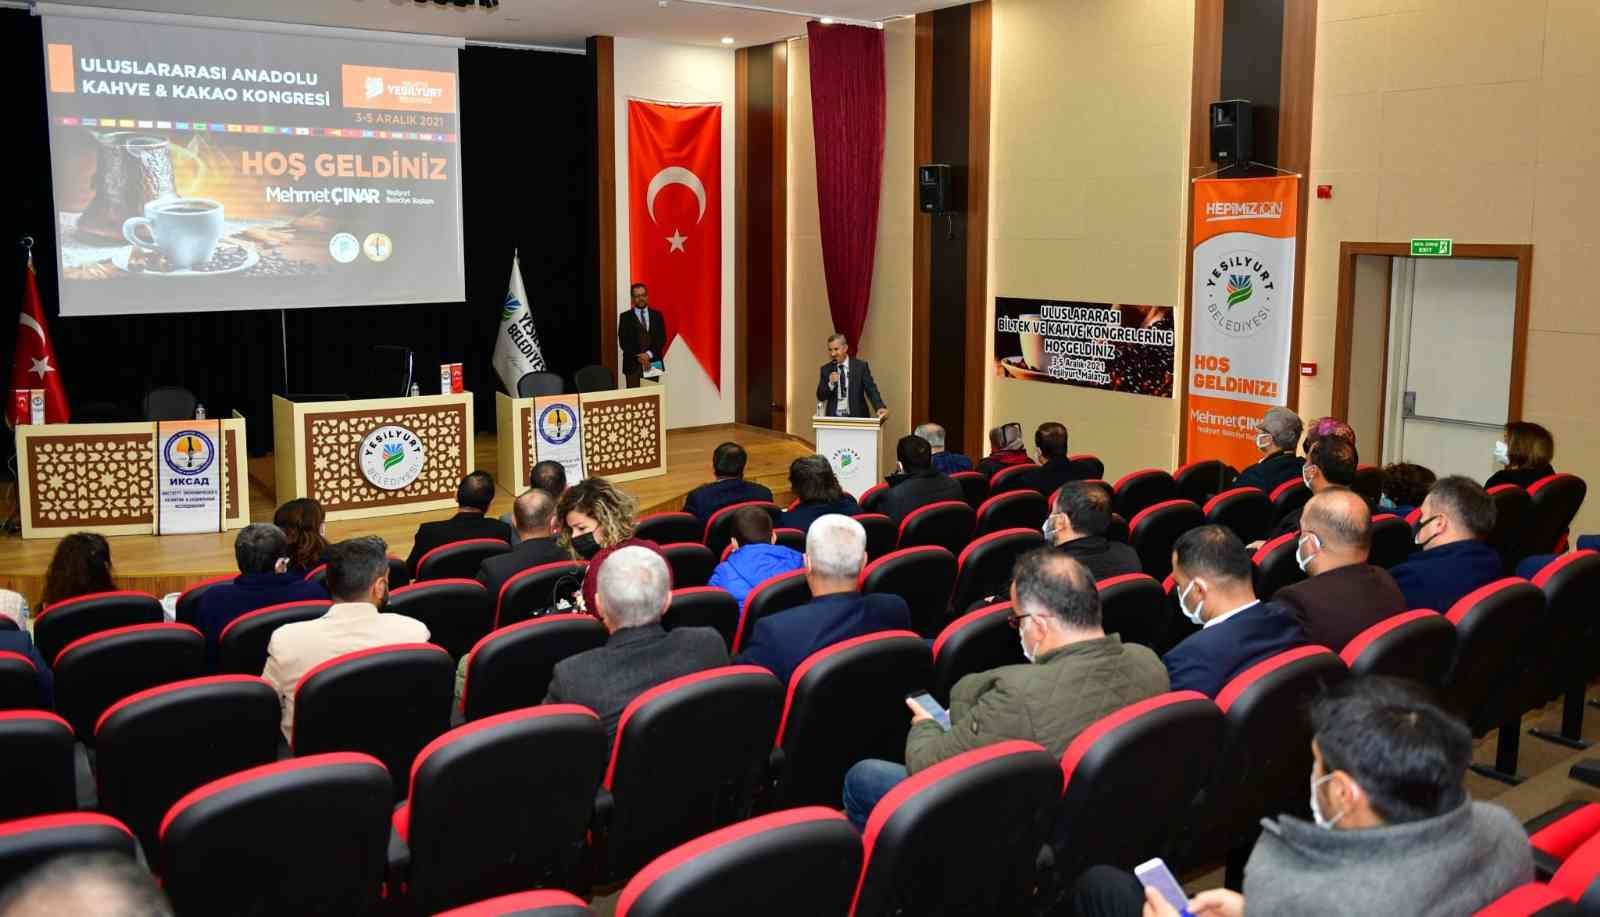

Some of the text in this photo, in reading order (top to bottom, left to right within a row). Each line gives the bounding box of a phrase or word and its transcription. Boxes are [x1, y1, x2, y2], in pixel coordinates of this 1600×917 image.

[81, 57, 318, 87] ULUSLARARASI ANADOLU
[82, 79, 330, 106] KAHVE & KAKAO KONGRESİ
[376, 113, 416, 126] ARALIK
[420, 115, 444, 128] 2021
[240, 150, 449, 180] HOŞ GELDİNİZ
[265, 186, 380, 206] Mehmet ÇINAR
[1041, 306, 1121, 324] ULUSLARARASI
[999, 316, 1172, 345] BİLTEK VE KAHVE KONGRELERİNE
[1045, 338, 1115, 359] HOŞGELDİNİZ
[1086, 359, 1105, 371] 2021
[1193, 373, 1279, 399] GELDİNİZ!
[1191, 408, 1237, 427] Mehmet
[169, 477, 210, 487] ИКСАД
